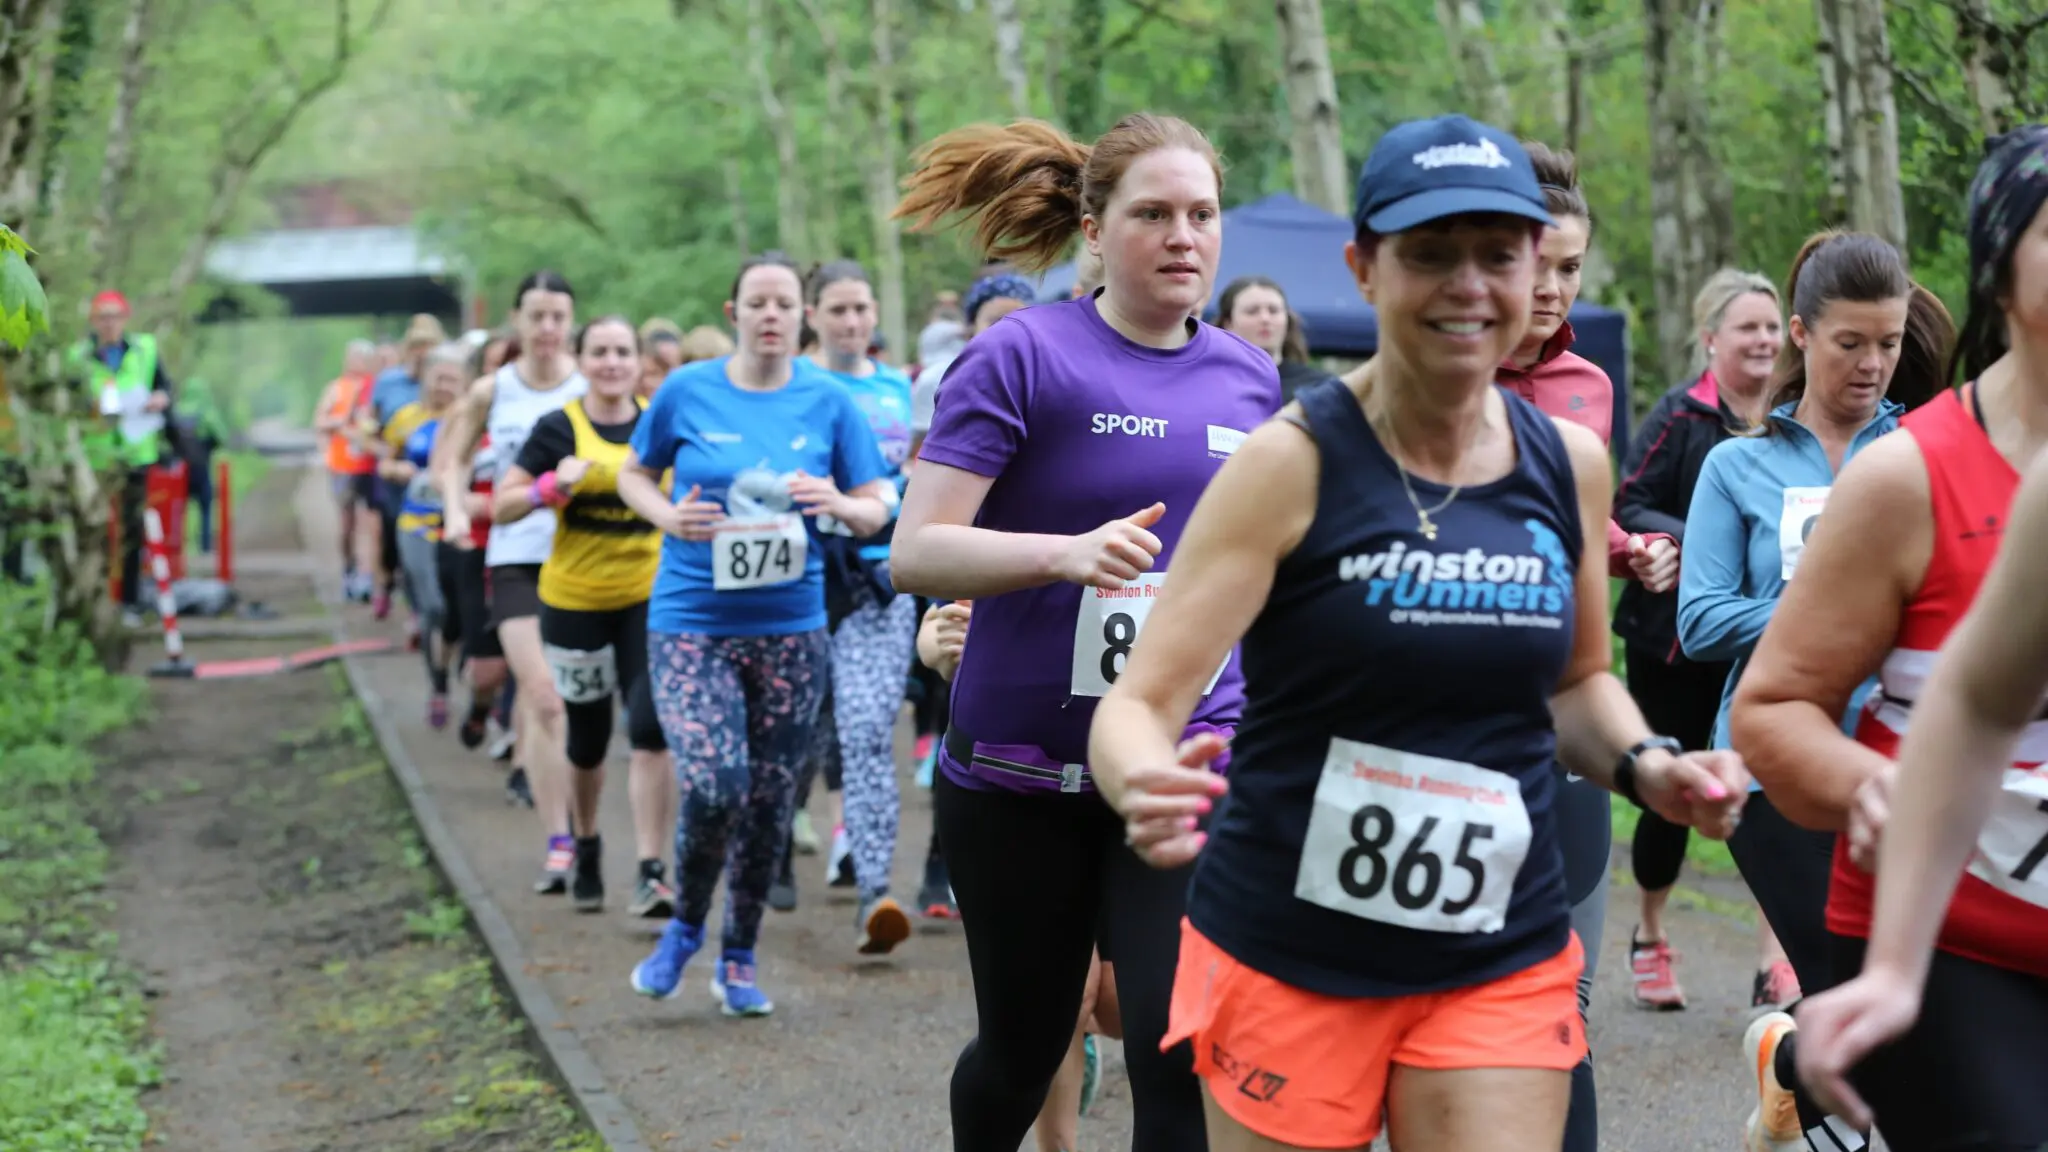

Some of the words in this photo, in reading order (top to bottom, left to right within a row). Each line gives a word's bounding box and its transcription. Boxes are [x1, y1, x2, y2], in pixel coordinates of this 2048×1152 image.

[1091, 413, 1168, 438] SPORT
[730, 538, 792, 580] 874
[1338, 541, 1544, 585] winston
[1365, 570, 1564, 612] runners
[1338, 804, 1494, 915] 865
